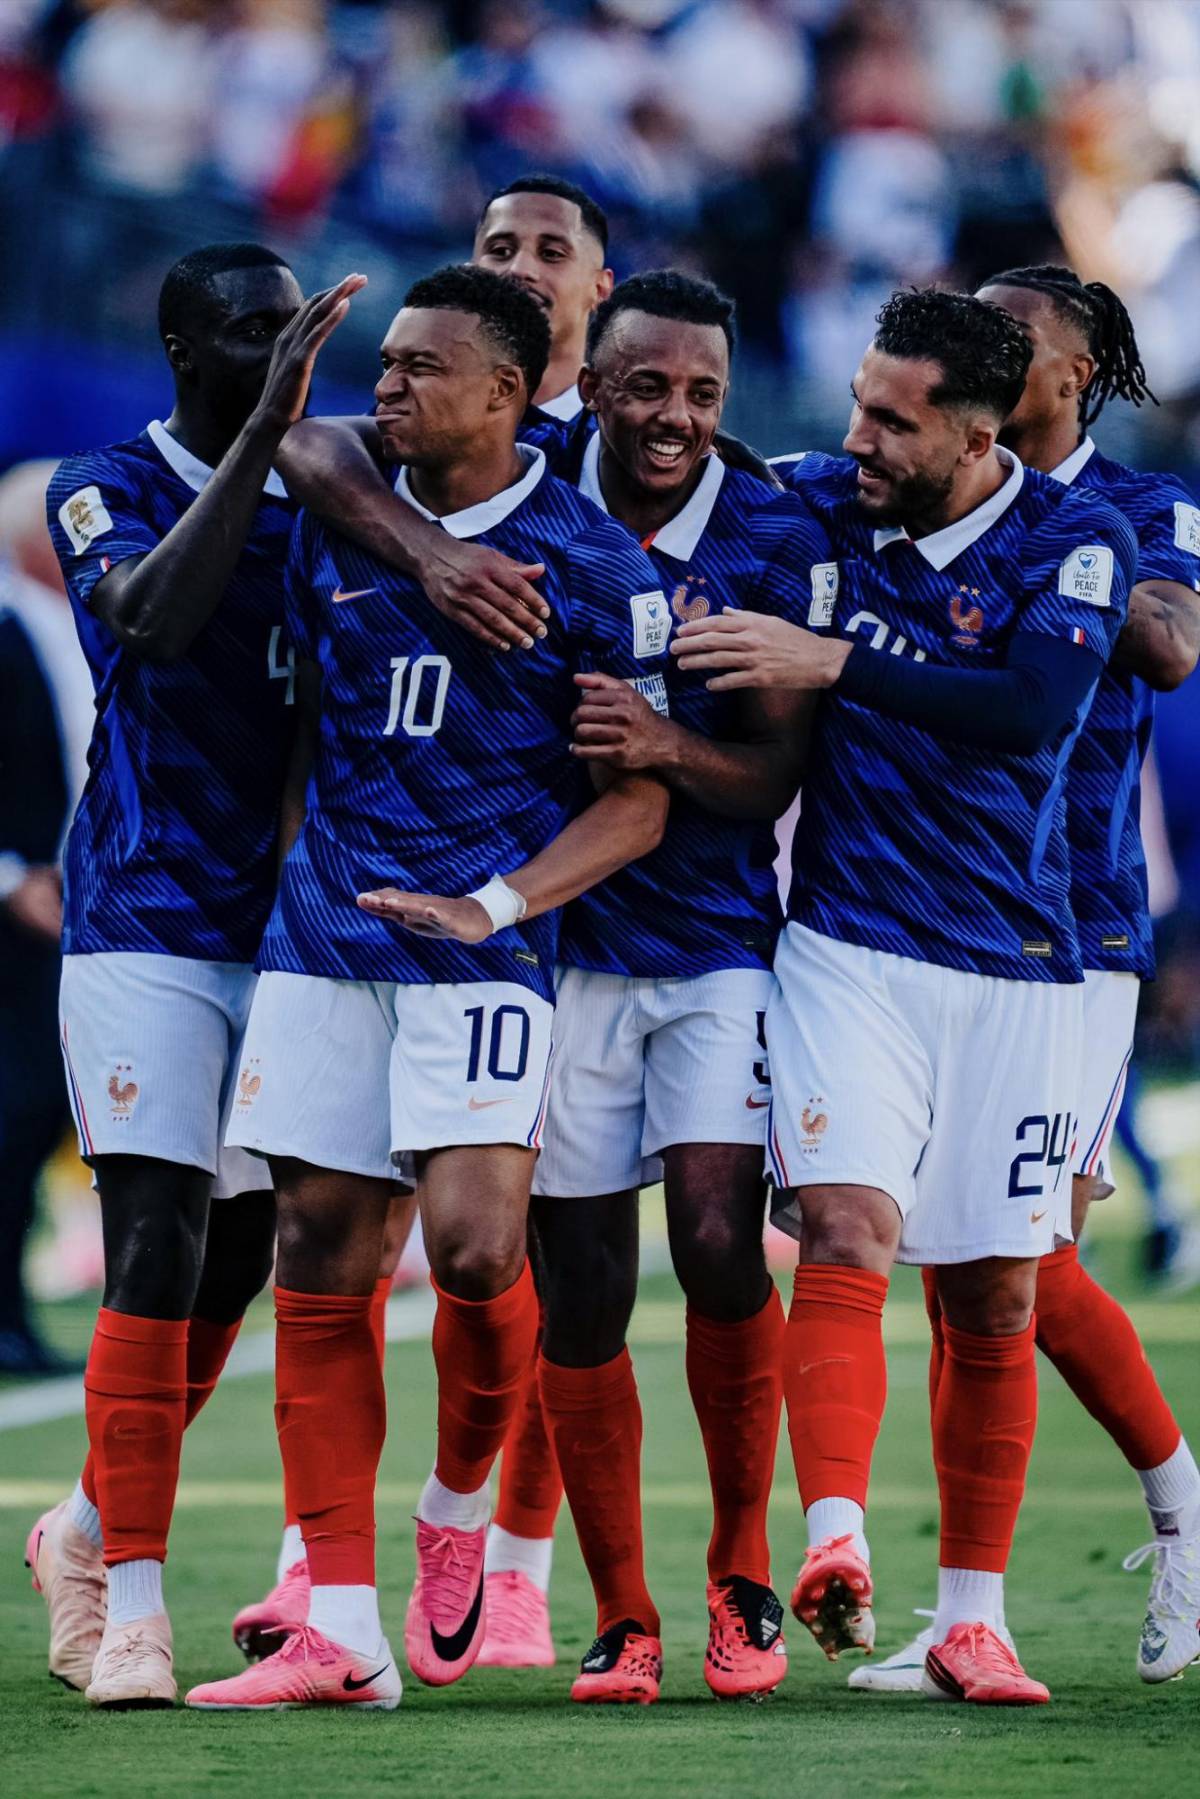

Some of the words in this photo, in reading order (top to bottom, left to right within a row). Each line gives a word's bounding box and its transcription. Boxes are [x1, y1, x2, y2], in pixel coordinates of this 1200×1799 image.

[1074, 580, 1099, 592] PEACE
[382, 655, 452, 737] 10
[464, 1004, 531, 1082] 10
[1008, 1112, 1071, 1198] 24
